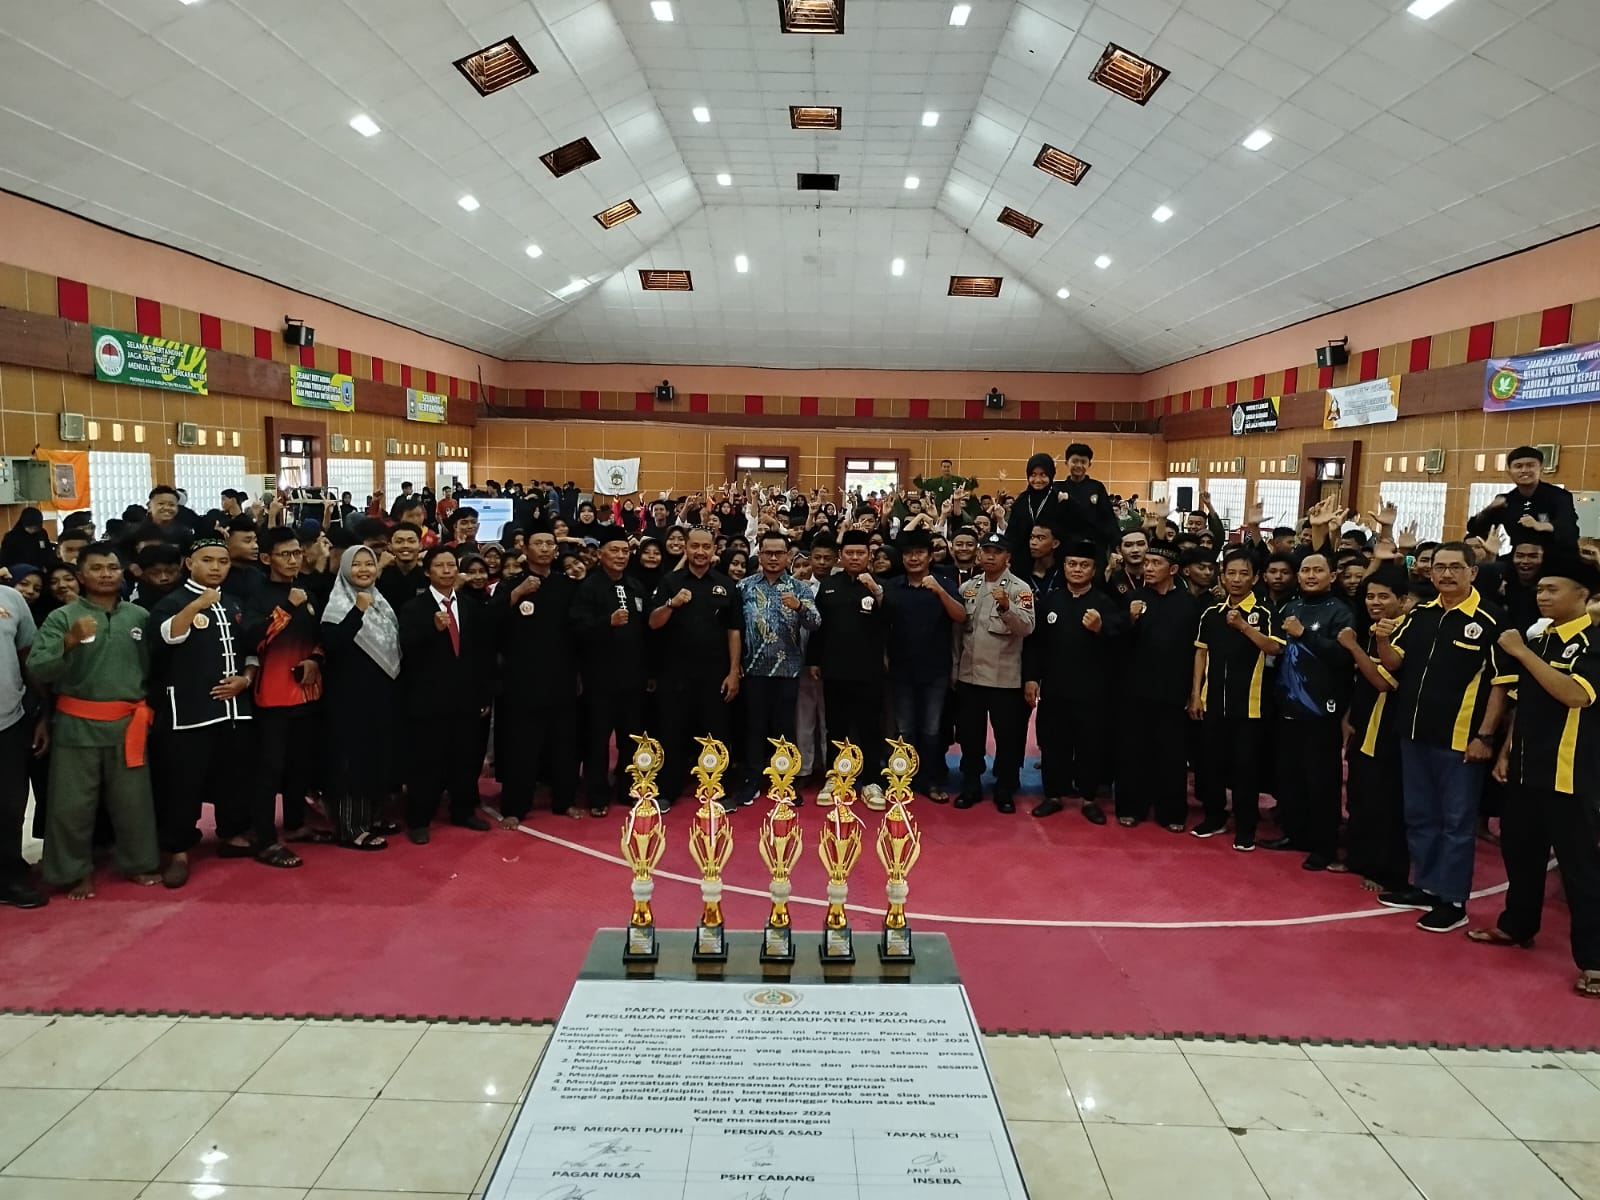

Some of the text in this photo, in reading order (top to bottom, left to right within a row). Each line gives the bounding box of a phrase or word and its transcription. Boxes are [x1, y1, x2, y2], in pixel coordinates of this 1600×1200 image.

[128, 352, 142, 361] JAGA
[128, 362, 151, 372] MENUJU
[741, 1090, 852, 1098] bertanggungjawab
[693, 1116, 831, 1125] Yang menandatangani
[723, 1128, 784, 1136] PERSINAS
[551, 1170, 641, 1179] PAGAR NUSA
[757, 1174, 815, 1182] CABANG
[912, 1177, 962, 1185] INSEBA
